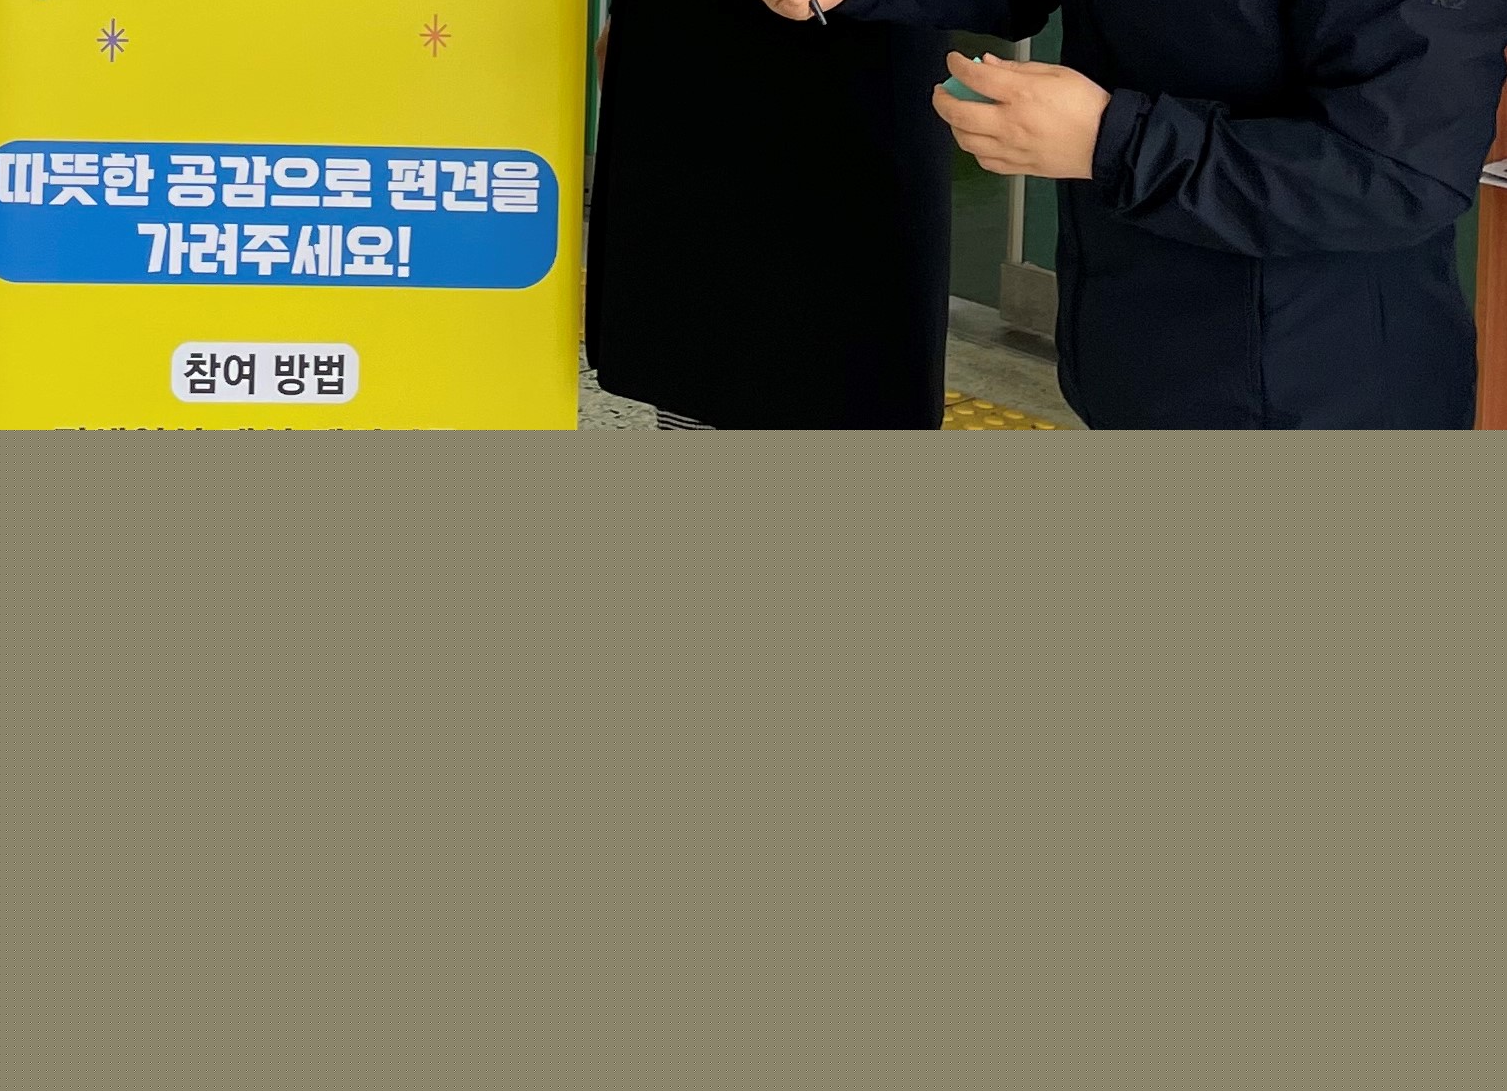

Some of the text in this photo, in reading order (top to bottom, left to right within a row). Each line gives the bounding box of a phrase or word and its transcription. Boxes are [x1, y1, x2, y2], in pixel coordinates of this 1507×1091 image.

[168, 154, 373, 209] 공감으로
[388, 159, 541, 213] 편견을
[138, 223, 413, 278] 가려주세요!
[184, 352, 346, 396] 참여 방법
